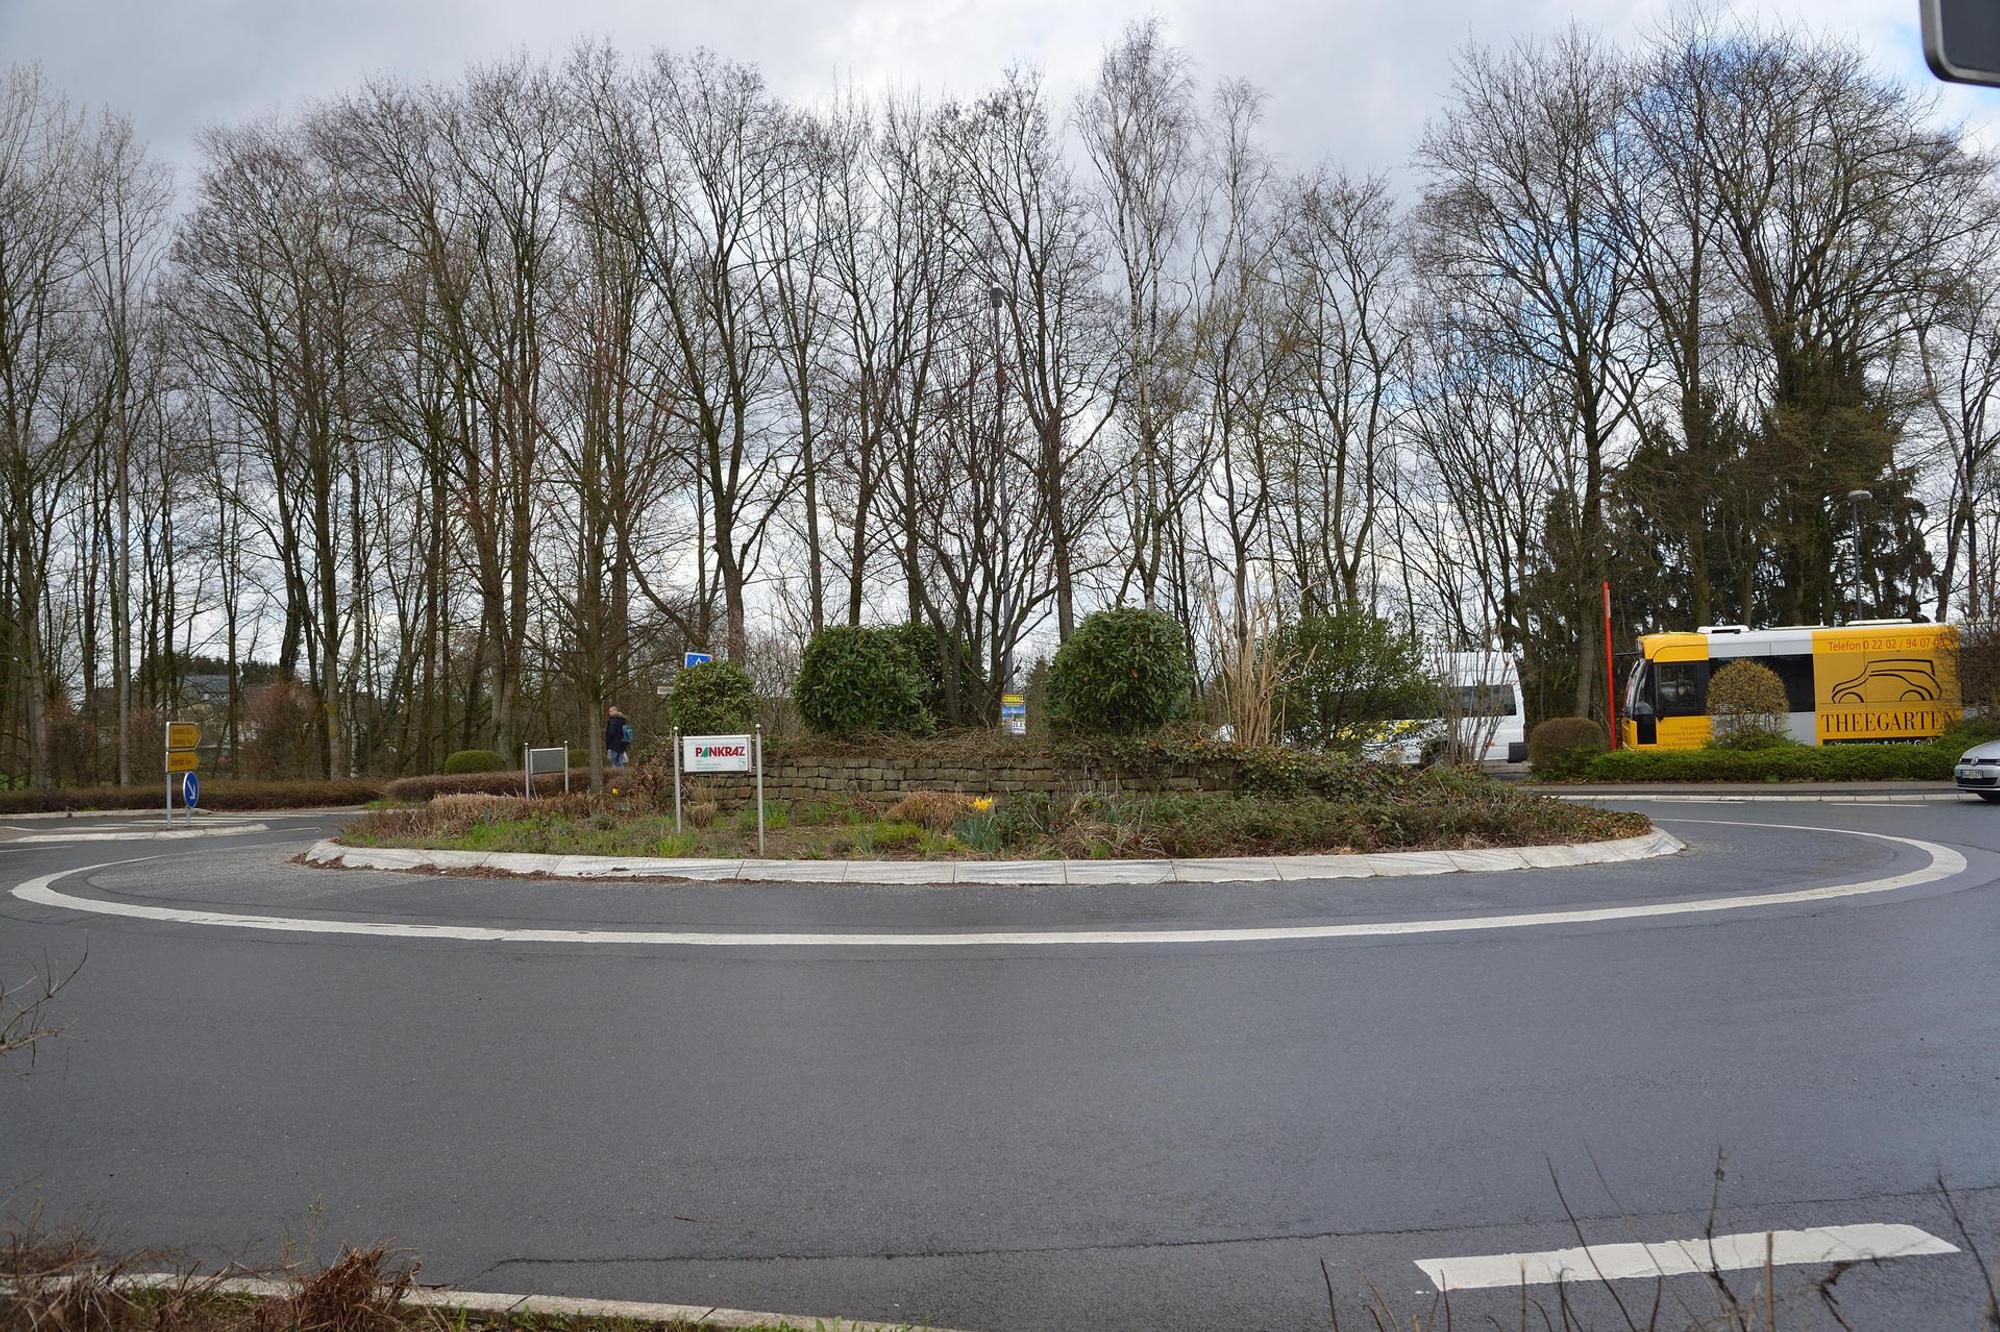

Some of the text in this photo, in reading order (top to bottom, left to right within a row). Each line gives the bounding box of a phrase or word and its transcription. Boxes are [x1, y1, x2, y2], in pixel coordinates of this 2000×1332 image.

[1828, 641, 1861, 651] Telefon
[1862, 640, 1869, 649] 0
[1872, 640, 1883, 649] 22
[1885, 640, 1896, 649] 02
[1906, 639, 1917, 648] 94
[1920, 639, 1931, 648] 07
[695, 746, 746, 758] PANKRAZ
